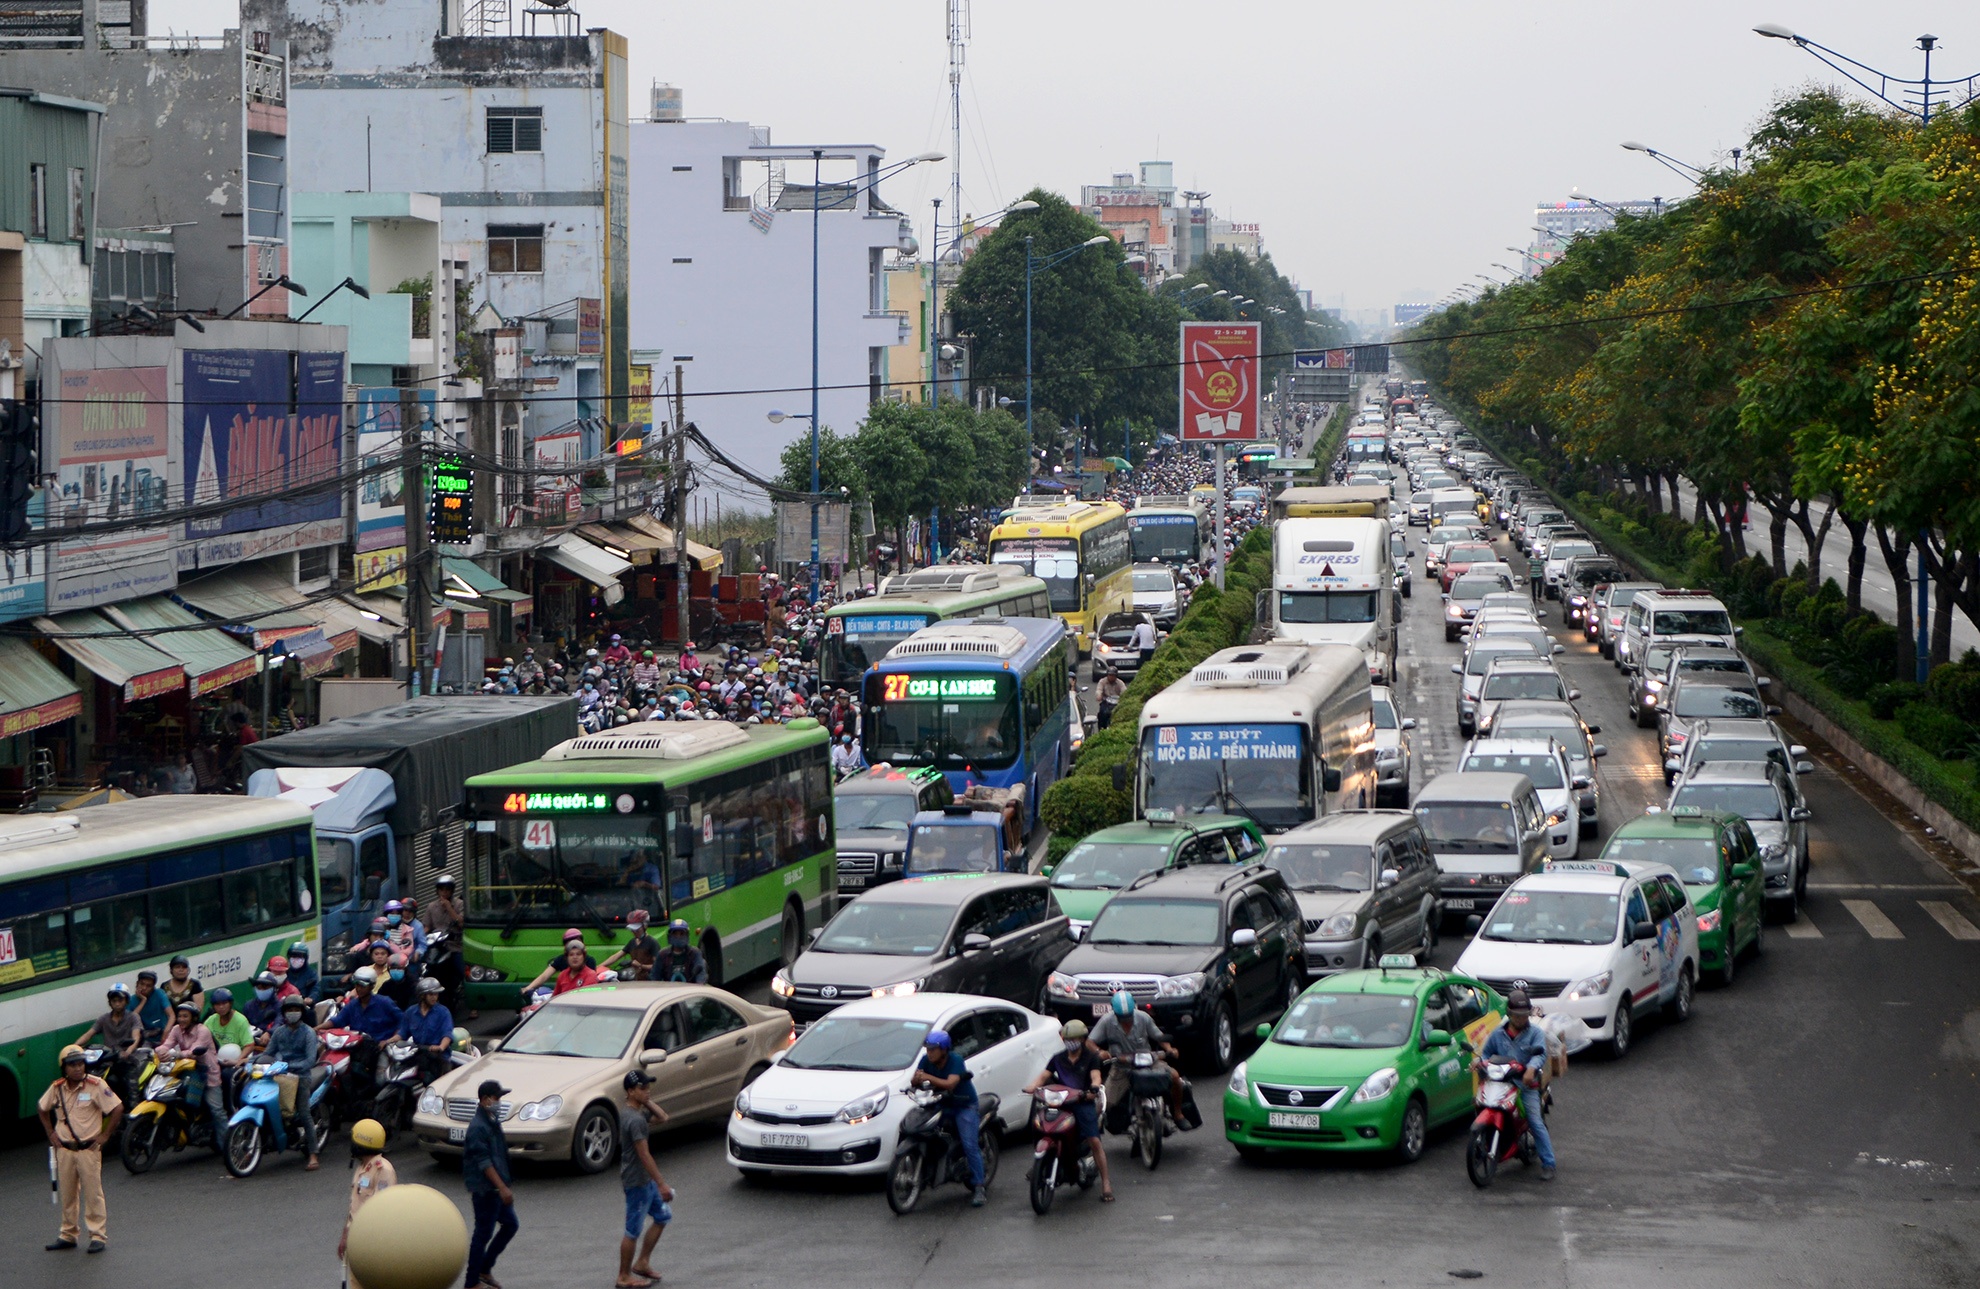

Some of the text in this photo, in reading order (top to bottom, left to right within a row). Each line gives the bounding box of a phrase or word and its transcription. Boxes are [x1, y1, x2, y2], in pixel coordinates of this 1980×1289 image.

[437, 475, 468, 493] Nệm
[1298, 555, 1360, 565] EXPRESS
[829, 617, 841, 633] 65
[846, 619, 857, 631] BẾN
[857, 618, 874, 631] THÀNH
[884, 674, 910, 700] 27
[1160, 728, 1177, 743] 703
[1190, 731, 1213, 741] XE
[1157, 739, 1297, 765] MỘC BÀI BẾN THÀNH
[504, 793, 527, 813] 41
[527, 822, 551, 846] 41
[704, 818, 712, 839] 41
[197, 956, 242, 980] 51LD-5929
